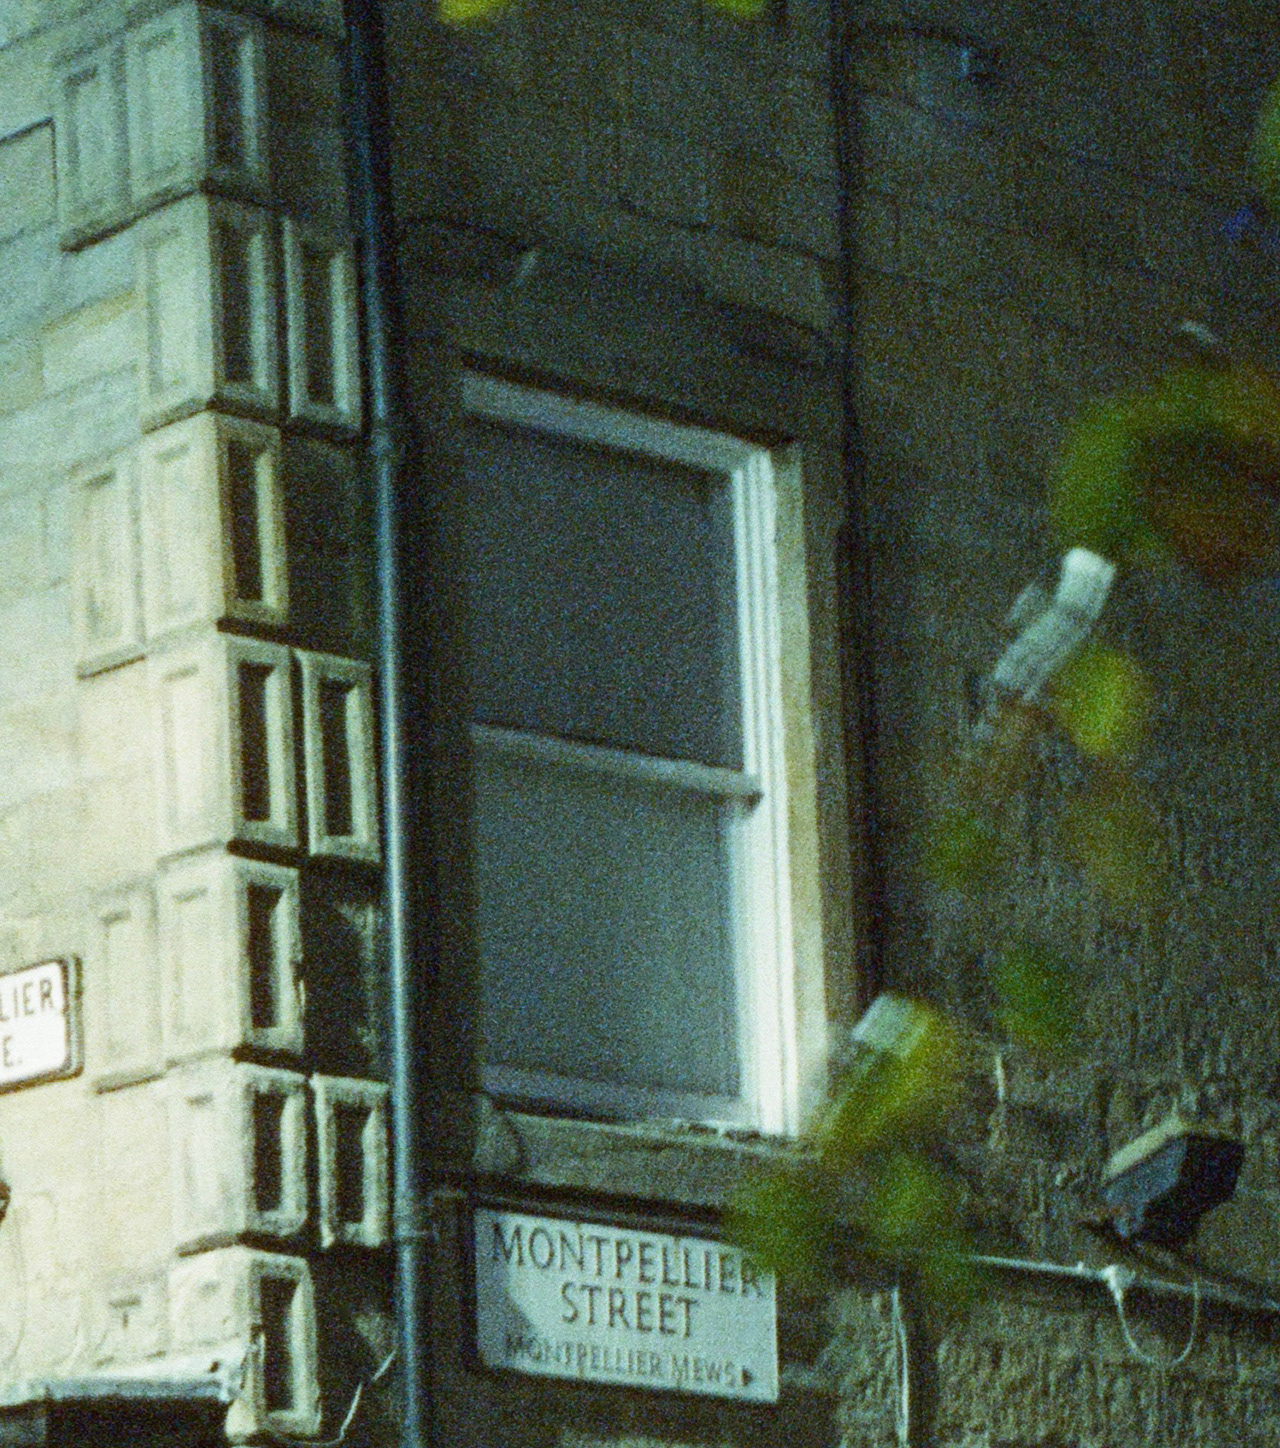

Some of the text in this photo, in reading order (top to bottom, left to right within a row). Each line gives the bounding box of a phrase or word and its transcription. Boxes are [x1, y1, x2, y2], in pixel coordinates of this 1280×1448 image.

[490, 1220, 763, 1299] MONTPELLIER
[560, 1281, 699, 1339] STREET
[504, 1333, 736, 1388] MONTPELLIER MEWS
